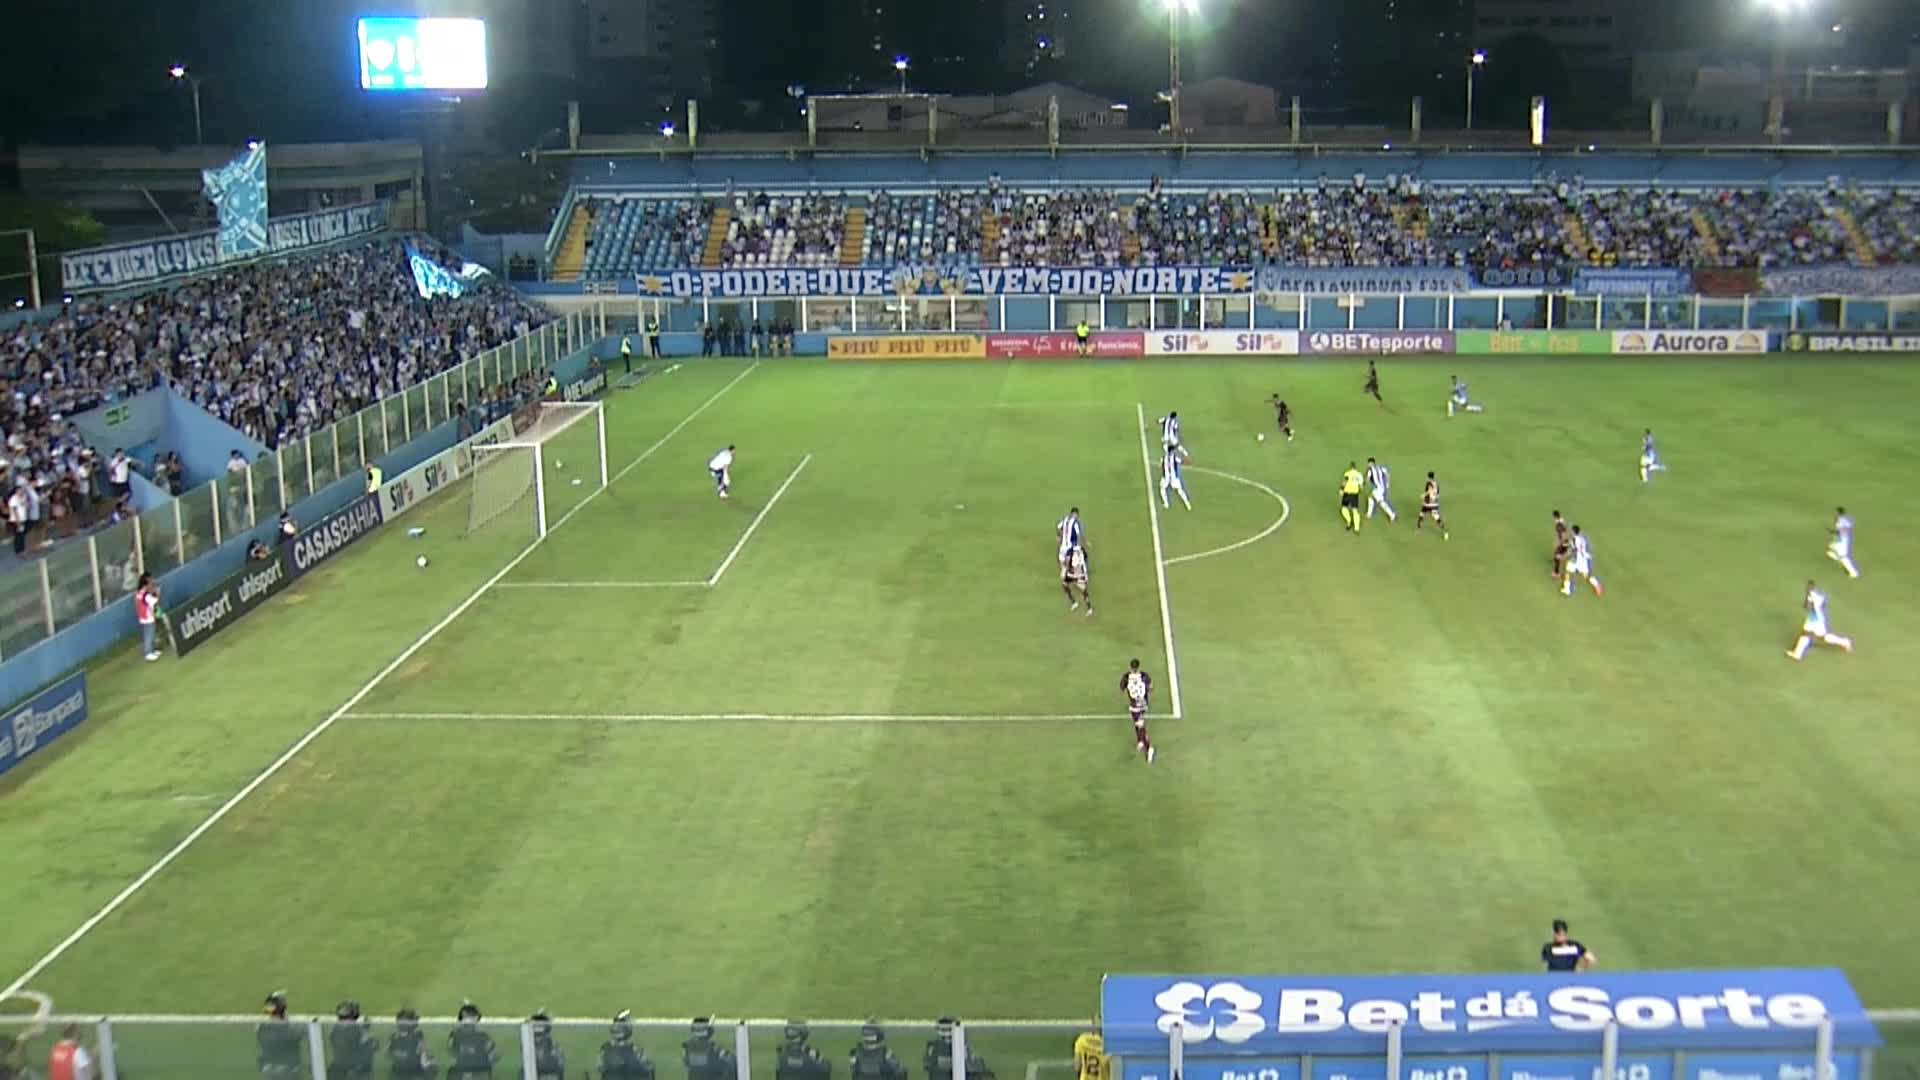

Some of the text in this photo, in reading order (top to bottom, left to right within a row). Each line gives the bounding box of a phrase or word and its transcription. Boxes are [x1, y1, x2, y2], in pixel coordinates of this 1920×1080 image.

[671, 267, 1220, 297] O PODER QUE VEM DO NORTE
[1163, 334, 1188, 352] Sil
[1236, 333, 1262, 352] Sil
[1331, 334, 1443, 352] BETesporte
[1652, 333, 1729, 352] Aurora
[1808, 335, 1920, 352] BRASILEI
[238, 558, 284, 603] uhlsport
[180, 590, 233, 640] uhlsport
[1278, 985, 1828, 1034] Bet dá Sorte
